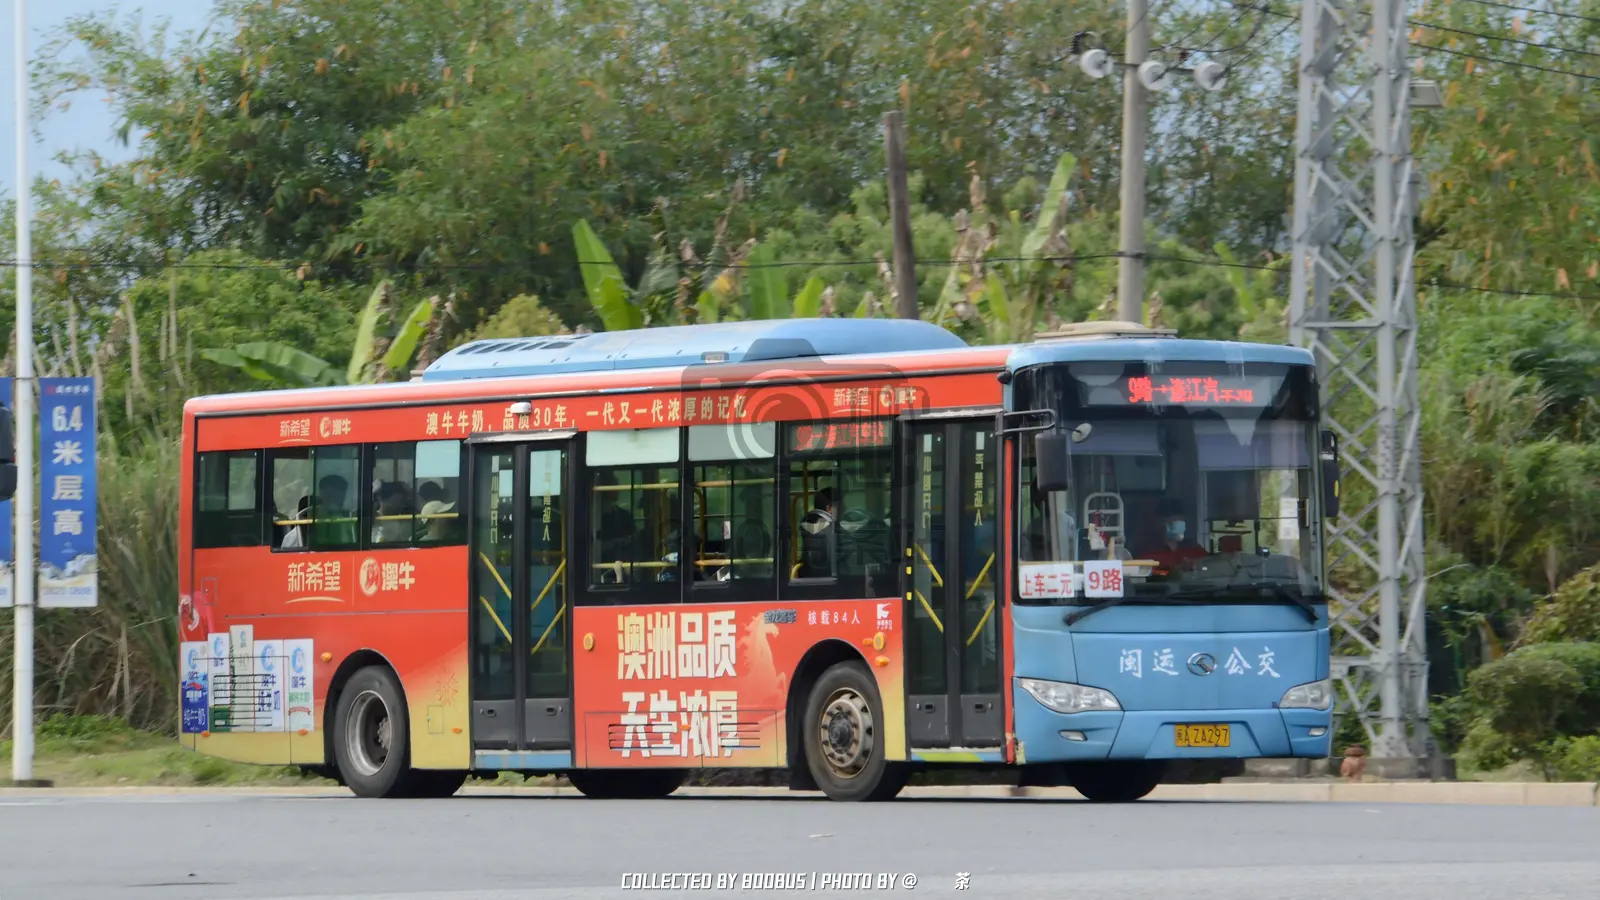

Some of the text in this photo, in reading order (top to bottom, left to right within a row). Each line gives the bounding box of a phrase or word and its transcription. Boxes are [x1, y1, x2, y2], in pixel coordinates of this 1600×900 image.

[279, 418, 310, 437] 新希望
[287, 560, 416, 592] 新希望 澳牛
[1022, 572, 1072, 596] 上车二元
[1088, 568, 1122, 592] 9路
[617, 610, 737, 680] 澳洲品质
[1119, 645, 1281, 679] 闽运 公交
[620, 689, 741, 758] 天生浓厚
